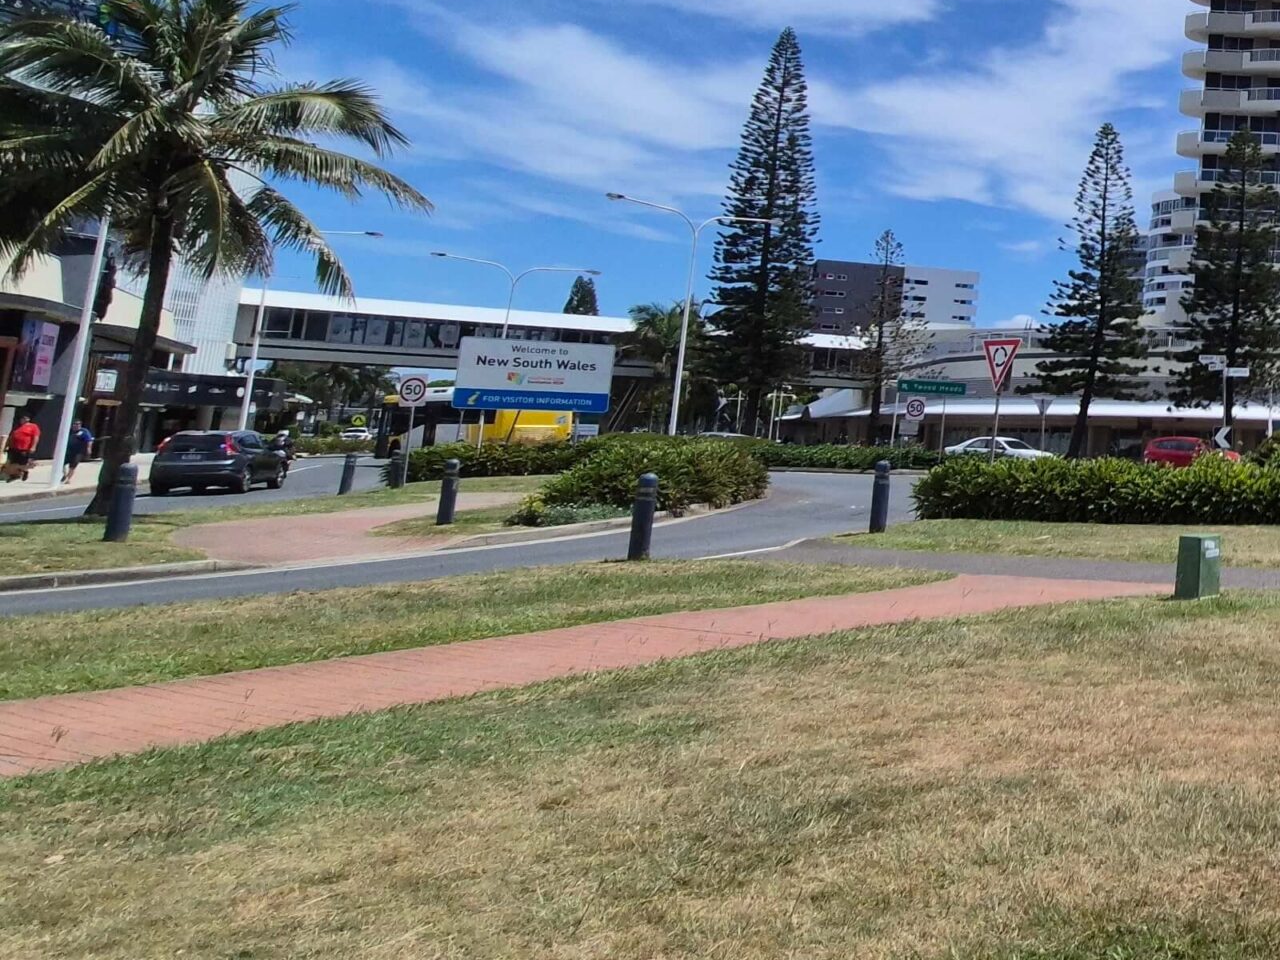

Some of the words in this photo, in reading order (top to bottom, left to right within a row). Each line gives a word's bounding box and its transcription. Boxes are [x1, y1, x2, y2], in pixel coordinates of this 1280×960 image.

[511, 345, 556, 355] Welcome
[476, 355, 509, 367] New
[512, 357, 552, 369] South
[556, 359, 597, 371] Wales
[405, 384, 421, 395] 50
[502, 396, 534, 404] VISITOR
[536, 397, 592, 406] INFORMATION
[910, 404, 923, 412] 50
